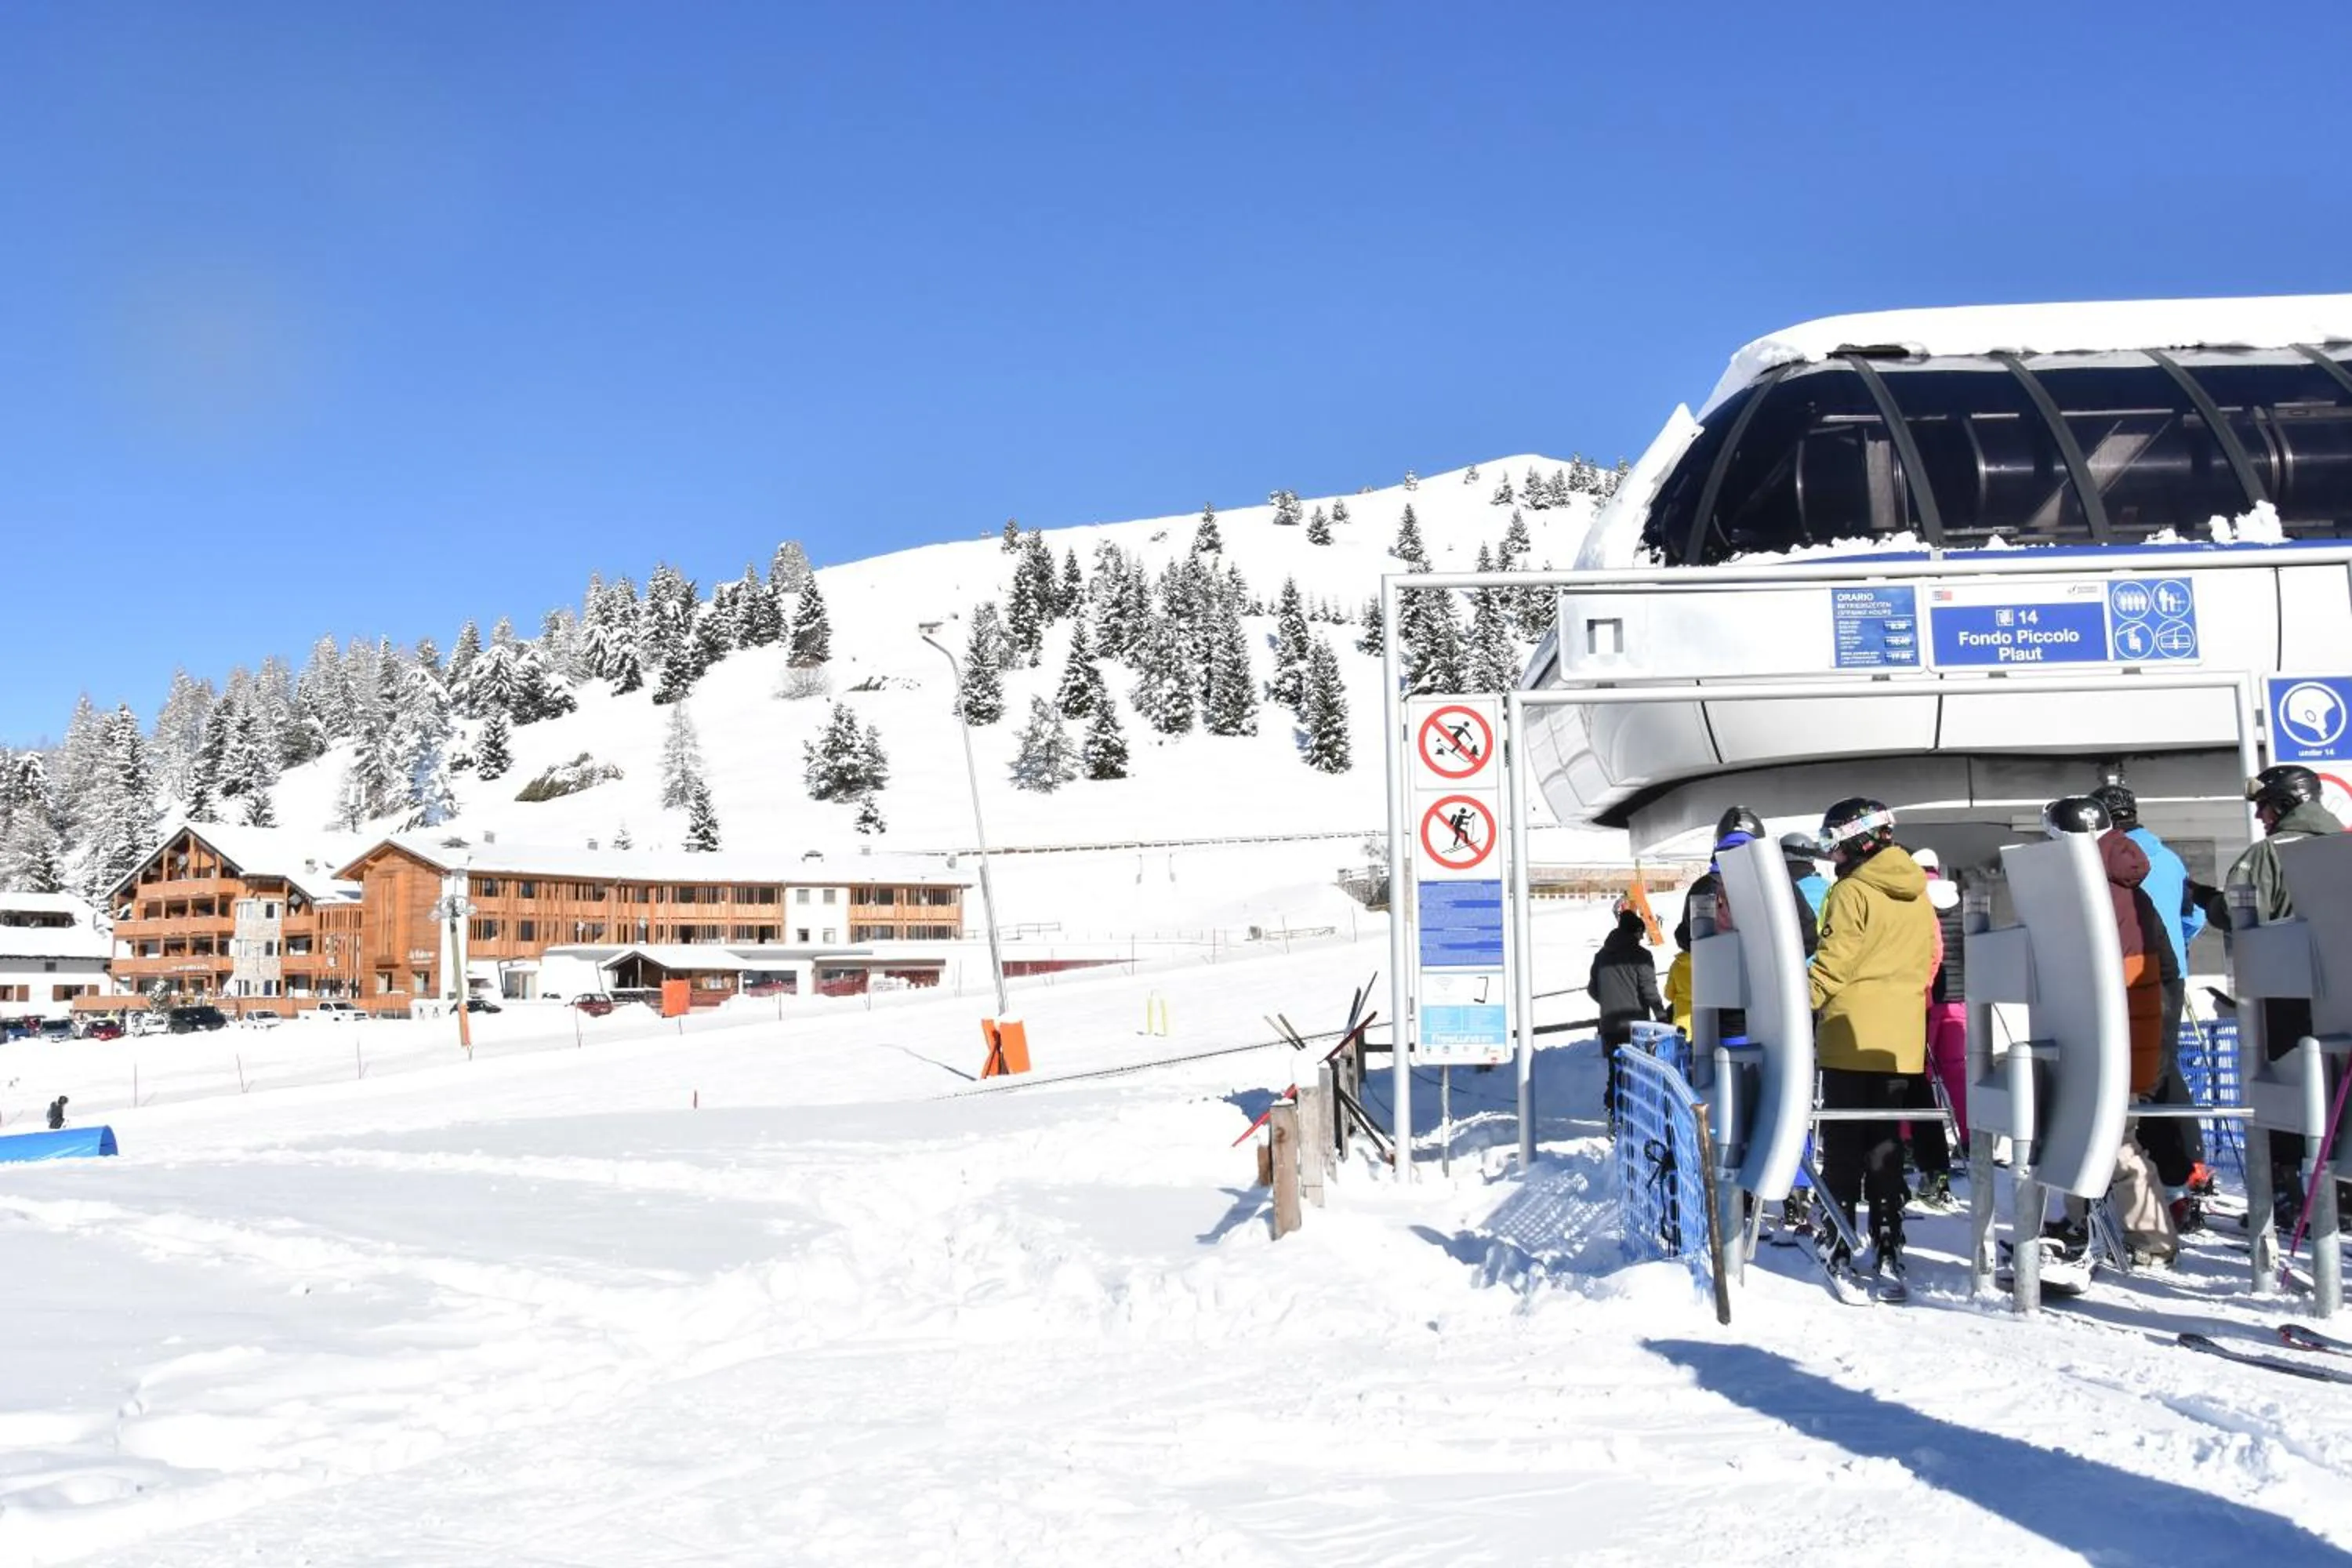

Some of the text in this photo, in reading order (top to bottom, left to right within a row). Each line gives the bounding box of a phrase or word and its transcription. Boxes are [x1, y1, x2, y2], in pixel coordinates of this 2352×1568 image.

[1837, 592, 1874, 602] ORARIO
[2018, 609, 2038, 625] 14
[1958, 628, 2080, 646] Fondo Piccolo
[1998, 646, 2044, 662] Plaut
